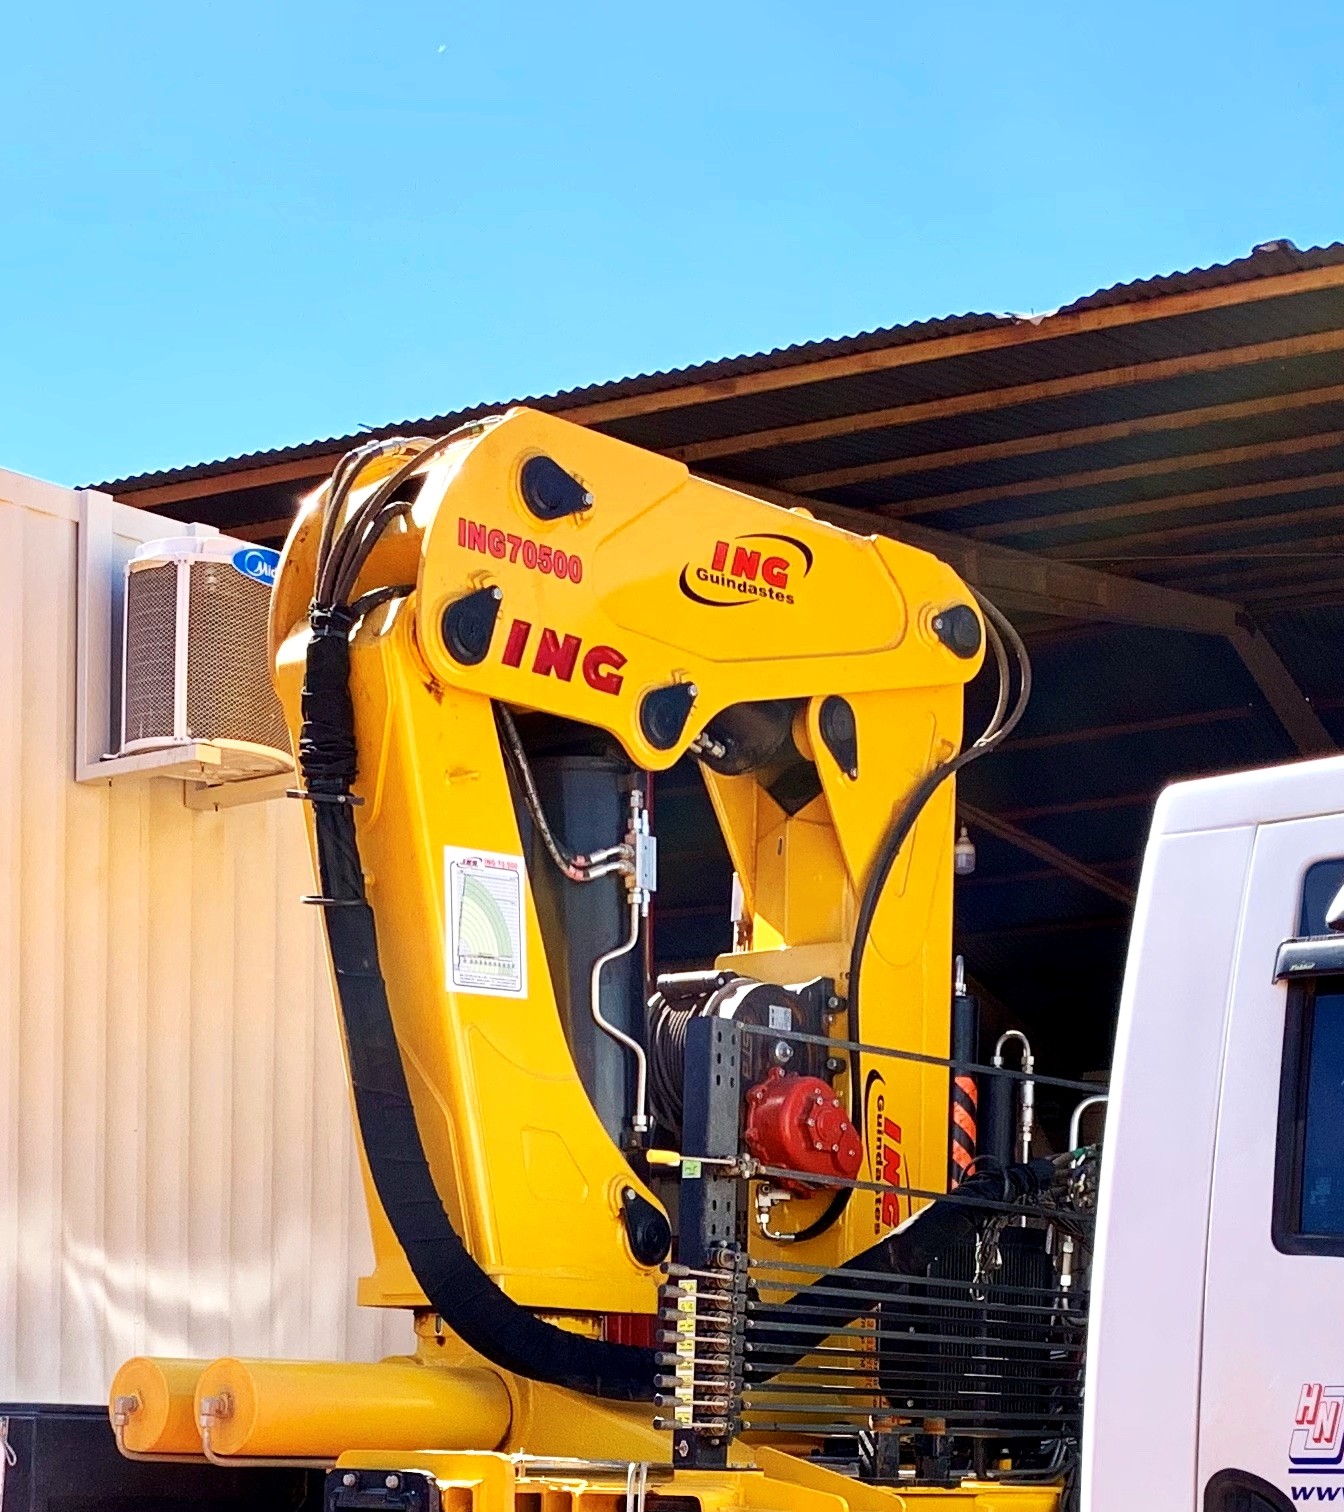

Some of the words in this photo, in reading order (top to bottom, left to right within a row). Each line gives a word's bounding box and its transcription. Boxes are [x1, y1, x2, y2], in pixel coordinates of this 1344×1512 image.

[458, 517, 583, 584] ING70500
[711, 540, 790, 589] ING
[696, 567, 795, 605] Guindastes
[501, 618, 628, 696] ING
[874, 1095, 884, 1235] Guindates
